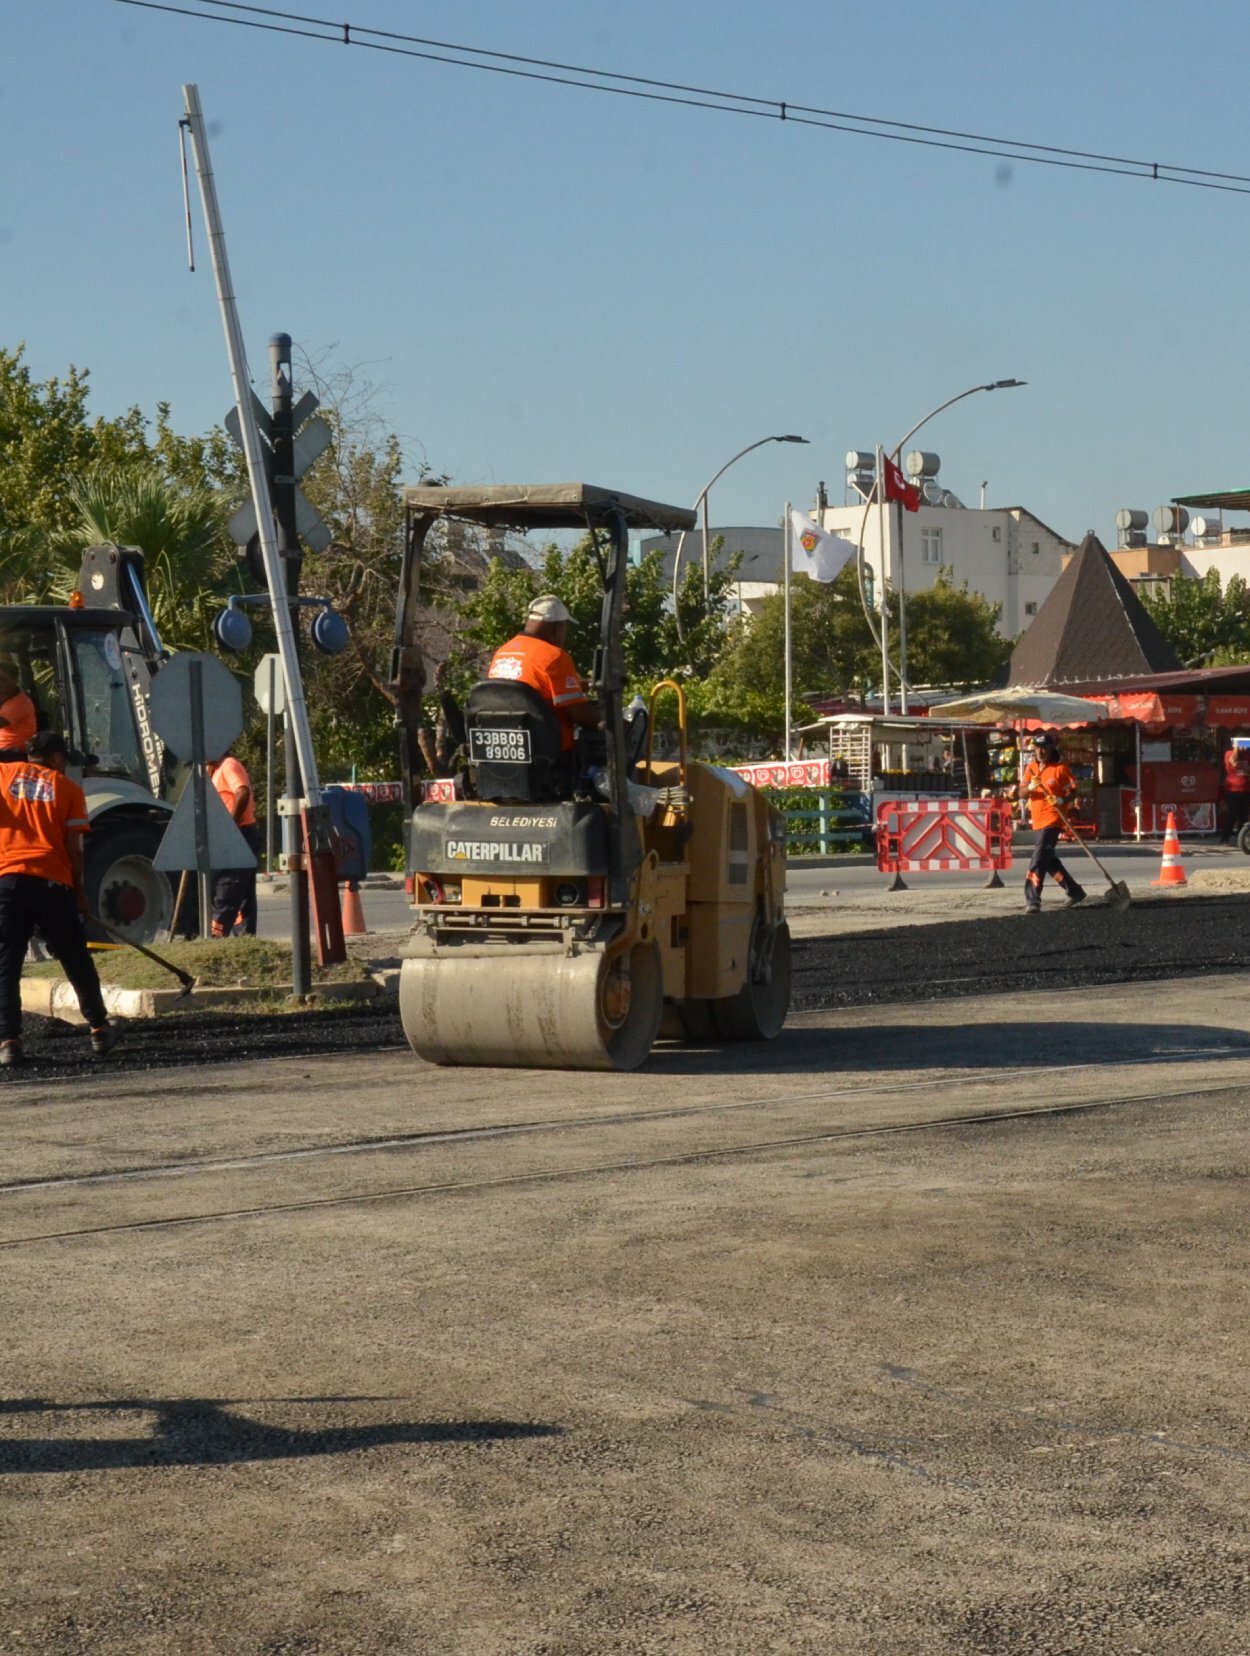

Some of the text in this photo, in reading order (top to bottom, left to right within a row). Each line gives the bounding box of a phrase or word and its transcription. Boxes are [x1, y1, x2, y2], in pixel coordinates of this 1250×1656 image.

[485, 746, 526, 760] 89006
[489, 816, 558, 828] BELEDİYESİ
[447, 840, 543, 862] CATERPILLAR
